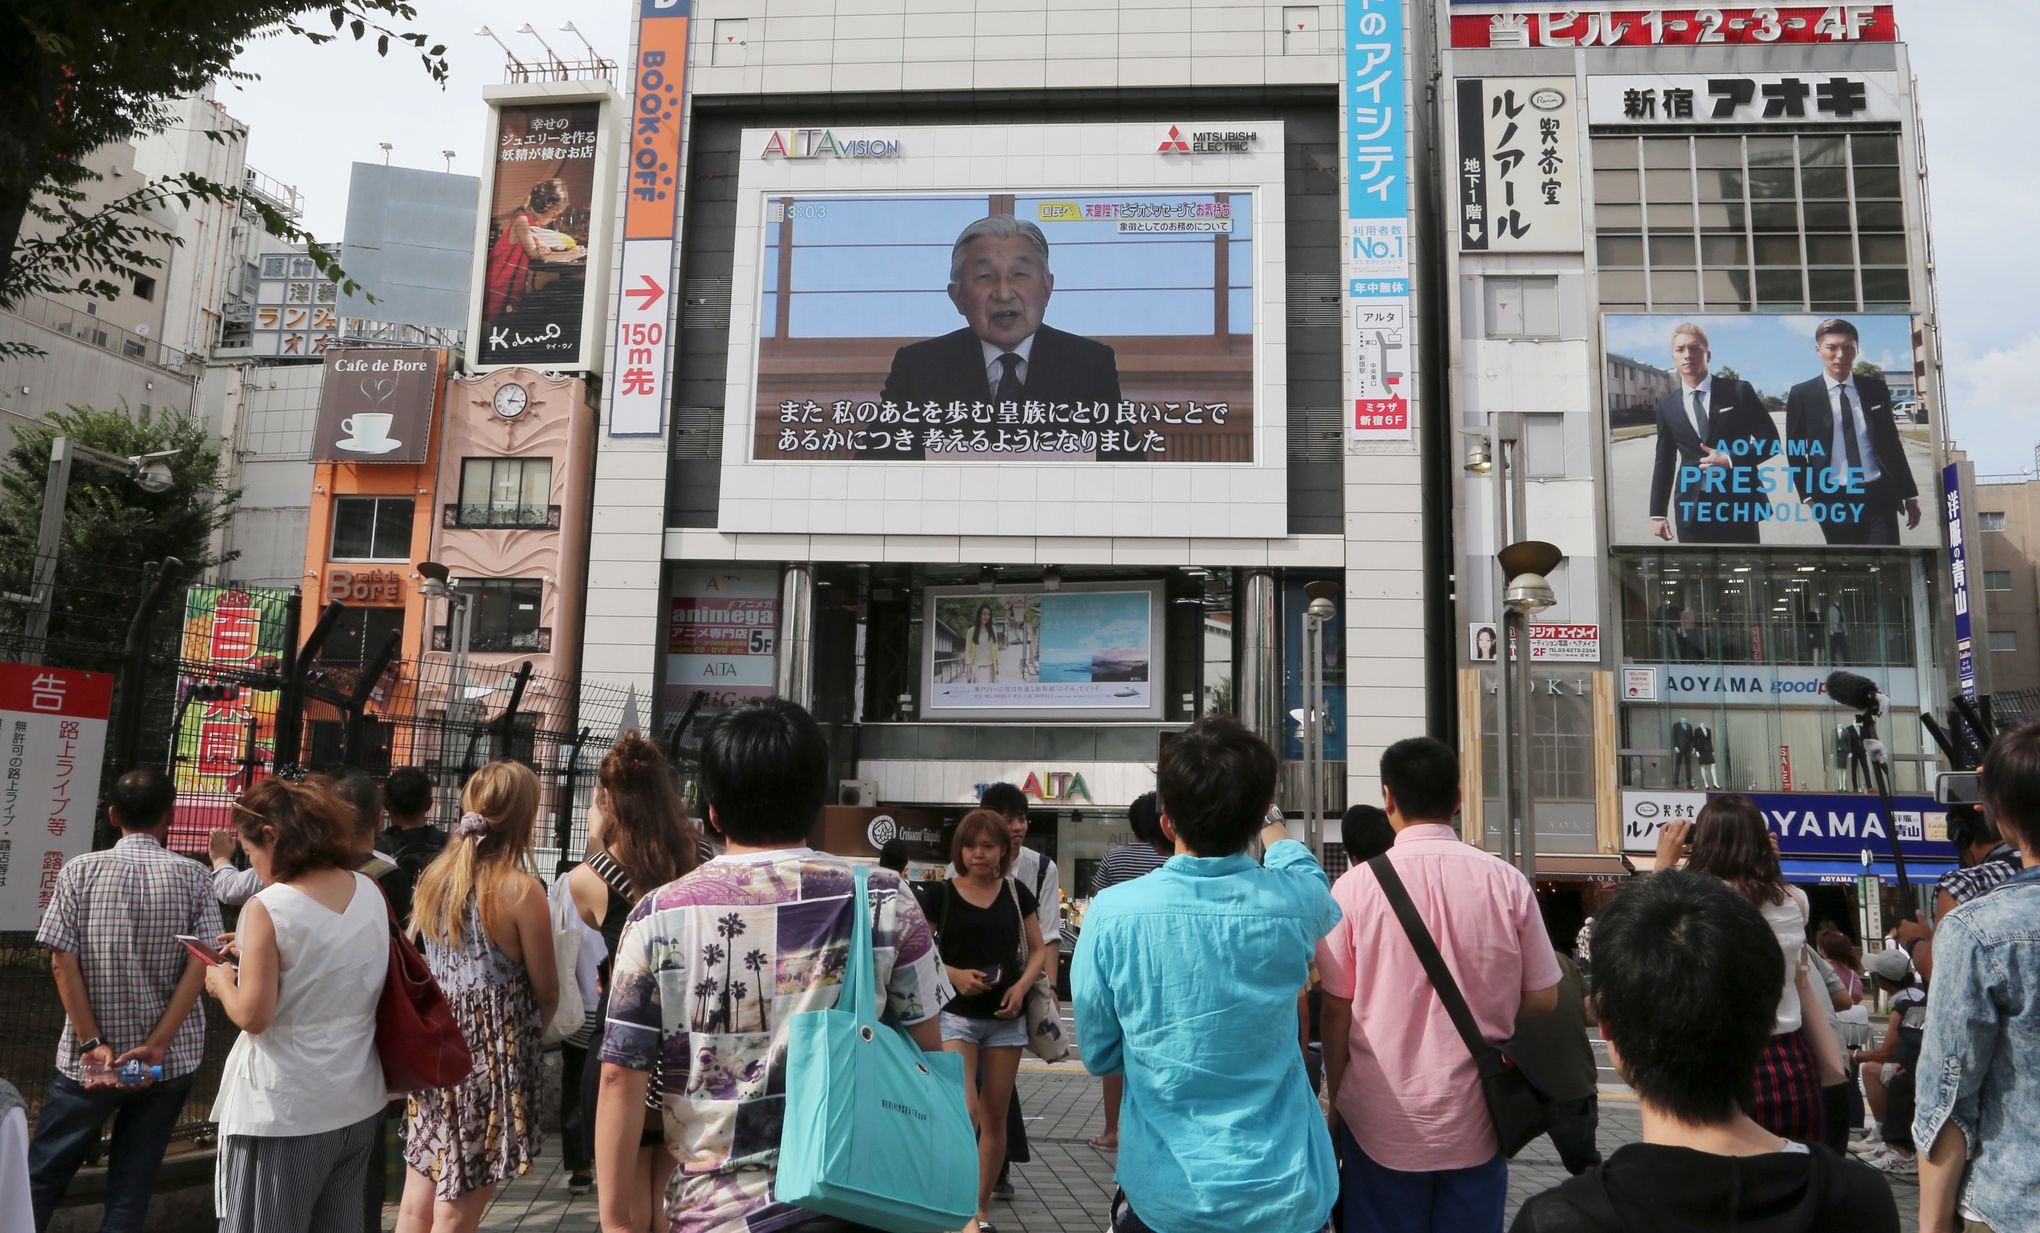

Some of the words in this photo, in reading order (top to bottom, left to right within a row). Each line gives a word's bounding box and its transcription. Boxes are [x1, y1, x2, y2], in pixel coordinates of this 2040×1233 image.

[1623, 87, 1694, 119] 新宿
[1707, 77, 1867, 118] アオキ
[530, 118, 568, 131] 幸せの
[501, 131, 595, 147] ジュエリーを作る
[761, 129, 839, 158] ALTA
[838, 139, 900, 158] VISION
[1193, 131, 1257, 142] MITSUBISHI
[501, 146, 593, 162] 妖精が棲むお店
[1193, 140, 1249, 152] ELECTRIC
[1491, 89, 1531, 239] ルノアール
[1537, 117, 1563, 205] 喫茶室
[1464, 158, 1482, 220] 地下1階
[787, 205, 826, 219] 3:03
[1042, 205, 1074, 218] 国民へ
[1085, 203, 1230, 218] 天皇陛下ビデオメッセージでお気持ち
[1353, 226, 1402, 235] 利用者数
[1353, 236, 1403, 258] No.1
[1354, 282, 1404, 294] 年中無休
[1363, 313, 1396, 322] アルタ
[335, 359, 368, 372] Cafe
[371, 360, 390, 372] de
[392, 360, 428, 372] Bore
[778, 401, 823, 424] また
[1365, 403, 1398, 413] ミラザ
[1359, 415, 1403, 426] 新宿6F
[777, 428, 915, 453] あるかにつき
[921, 429, 1166, 453] 考えるようになりました
[1715, 439, 1825, 456] AOYAMA
[1680, 466, 1865, 494] PRESTIGE
[1679, 502, 1864, 523] TECHNOLOGY
[1946, 490, 1968, 616] 洋服の青山
[671, 628, 748, 640] アニメ専門店
[1558, 627, 1597, 638] エイメイ
[750, 630, 772, 653] 5F
[1533, 648, 1547, 657] 2F
[703, 663, 737, 677] ALTA
[31, 673, 67, 712] 告
[1666, 676, 1764, 693] AOYAMA
[47, 720, 81, 837] 路上ライブ等
[1020, 771, 1090, 800] ALTA
